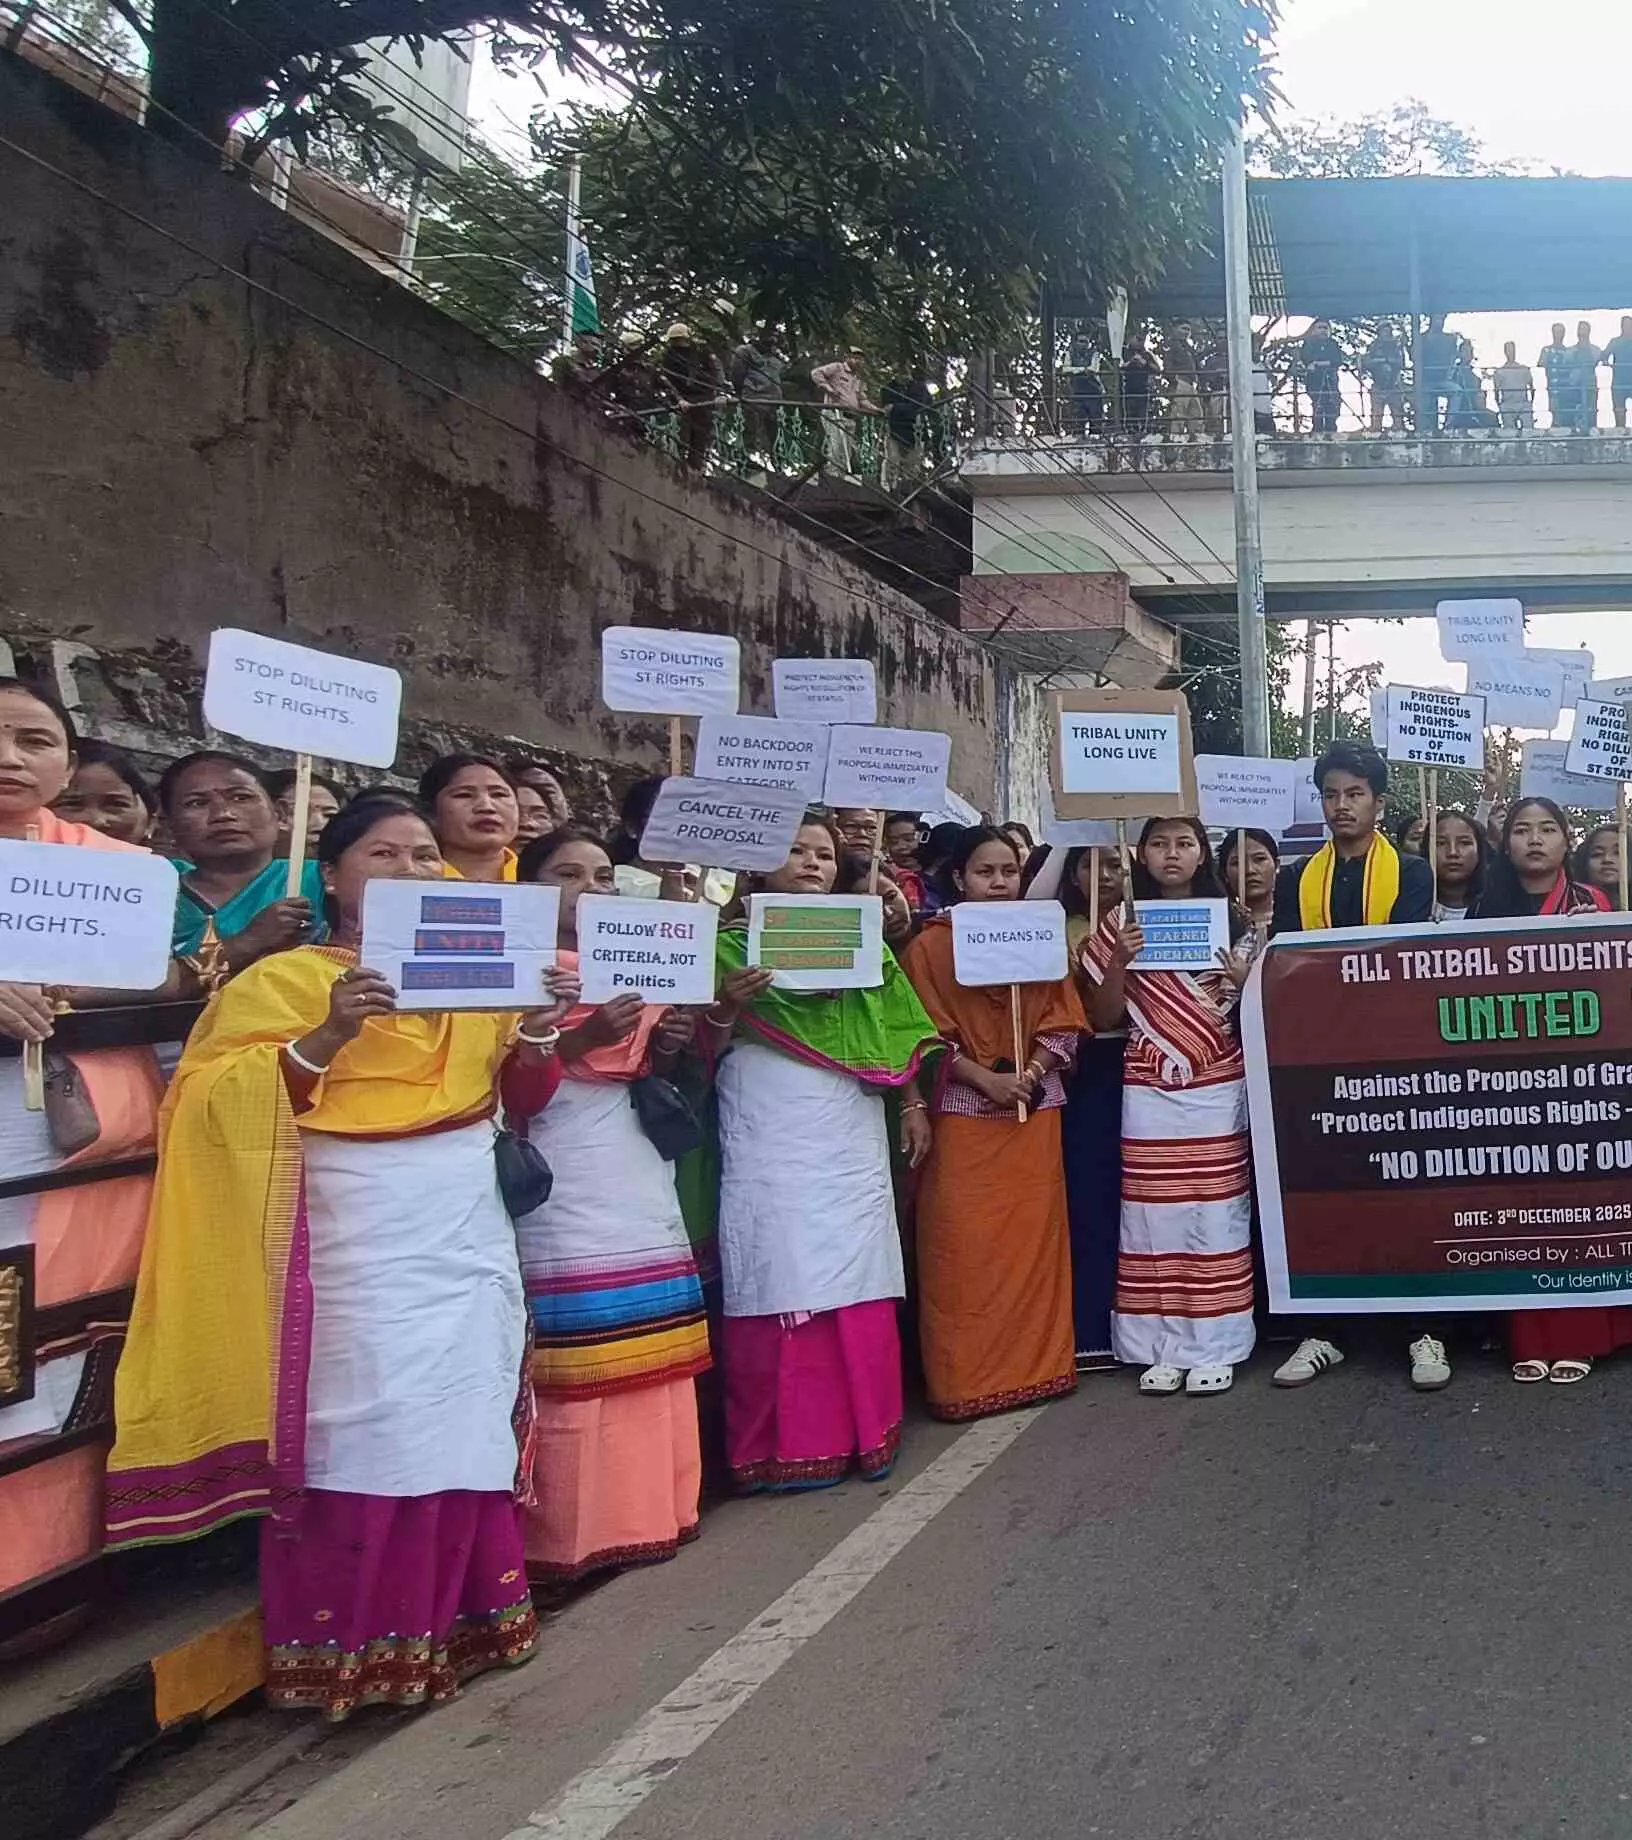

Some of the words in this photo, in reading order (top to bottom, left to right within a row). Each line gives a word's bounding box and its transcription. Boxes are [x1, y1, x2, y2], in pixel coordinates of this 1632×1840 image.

[1448, 616, 1483, 626] TRIBAL
[1484, 615, 1514, 625] UNITY
[1456, 633, 1487, 644] LONG
[620, 649, 656, 662] STOP
[660, 652, 724, 668] DILUTING
[234, 657, 285, 679] STOP
[290, 672, 378, 703] DILUTING
[635, 672, 652, 683] ST
[656, 673, 705, 687] RIGHTS
[1475, 681, 1492, 692] NO
[1494, 684, 1532, 697] MEANS
[1534, 688, 1551, 698] NO
[1411, 691, 1460, 706] PROTECT
[253, 690, 277, 707] ST
[282, 697, 356, 725] RIGHTS.
[1400, 701, 1471, 719] INDIGENOUS
[1414, 714, 1458, 728] RIGHTS-
[1071, 726, 1121, 740] TRIBAL
[1124, 727, 1167, 741] UNITY
[1399, 724, 1416, 736] NO
[1420, 726, 1471, 742] DILUTION
[718, 735, 740, 748] NO
[743, 739, 814, 753] BACKDOOR
[859, 746, 873, 754] WE
[874, 747, 903, 758] REJECT
[1428, 740, 1444, 750] OF
[1581, 738, 1600, 750] NO
[1084, 746, 1124, 760] LONG
[1128, 746, 1157, 760] LIVE
[1408, 749, 1422, 760] ST
[1424, 751, 1466, 764] STATUS
[1610, 755, 1628, 766] OF
[716, 755, 760, 769] ENTRY
[762, 759, 793, 772] INTO
[795, 761, 810, 772] ST
[838, 759, 882, 770] PROPOSAL
[883, 762, 939, 774] IMMEDIATELY
[1586, 764, 1603, 774] ST
[858, 774, 907, 785] WITHDRAW
[1200, 784, 1238, 793] PROPOSAL
[678, 800, 744, 820] CANCEL
[750, 808, 781, 824] THE
[676, 824, 765, 845] PROPOSAL
[10, 876, 144, 904] DILUTING
[0, 912, 107, 937] RIGHTS.
[597, 921, 657, 937] FOLLOW
[659, 921, 694, 940] RGI
[967, 932, 986, 944] NO
[989, 930, 1032, 943] MEANS
[1035, 928, 1054, 942] NO
[669, 953, 697, 966] NOT
[1341, 954, 1390, 982] ALL
[1398, 946, 1498, 980] TRIBAL
[612, 973, 676, 988] Politics
[1437, 989, 1601, 1043] UNITED
[1334, 1073, 1421, 1100] Against
[1423, 1071, 1462, 1095] the
[1466, 1064, 1568, 1093] Proposal
[1573, 1063, 1597, 1087] of
[1311, 1108, 1405, 1134] “Protect
[1410, 1103, 1541, 1129] Indigenous
[1547, 1099, 1621, 1124] Rights
[1369, 1149, 1419, 1180] “NO
[1425, 1145, 1549, 1177] DILUTION
[1556, 1142, 1589, 1173] OF
[1454, 1210, 1493, 1227] DATE:
[1519, 1206, 1591, 1224] DECEMBER
[1596, 1203, 1632, 1221] 2025
[1446, 1248, 1541, 1266] Organised
[1546, 1247, 1568, 1264] by
[1585, 1245, 1614, 1259] ALL
[1568, 1270, 1622, 1289] Identity
